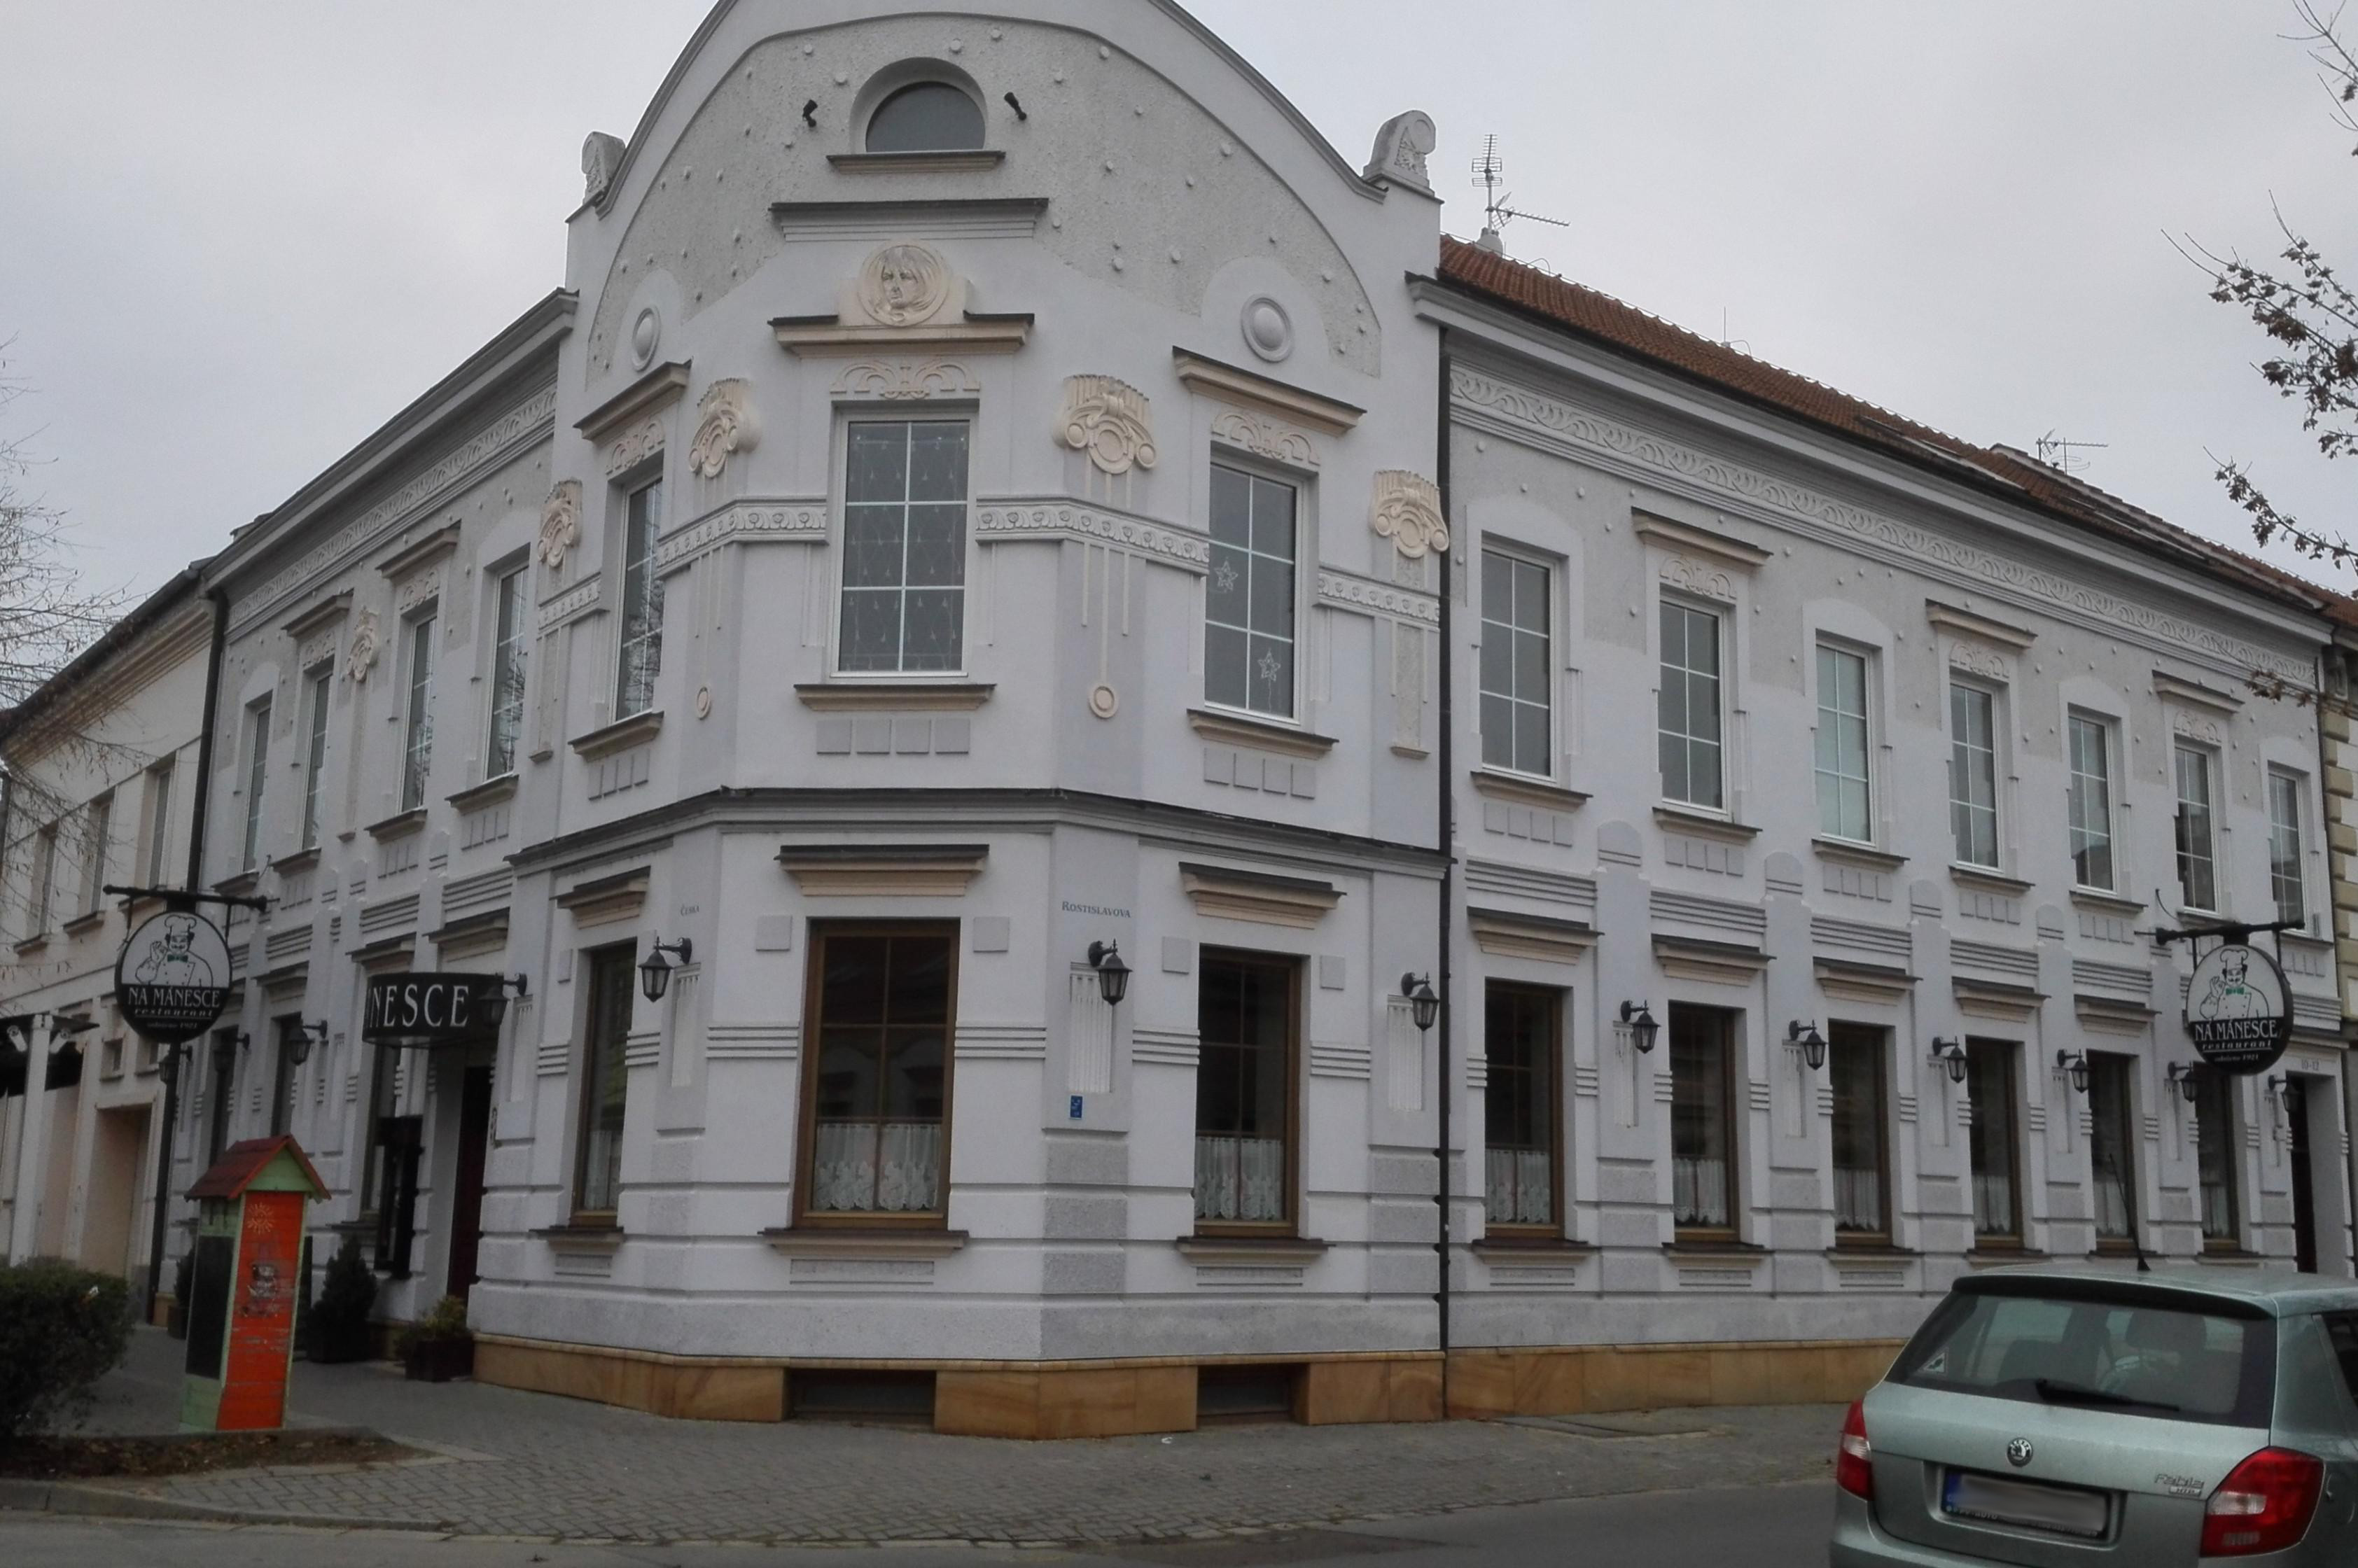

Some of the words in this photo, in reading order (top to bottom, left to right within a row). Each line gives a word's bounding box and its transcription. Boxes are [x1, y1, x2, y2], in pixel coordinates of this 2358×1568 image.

[1062, 901, 1131, 918] ROSTISLAVOVA
[128, 987, 148, 1006] NA
[153, 986, 221, 1008] MÁNESCE
[367, 983, 469, 1028] NESCE
[134, 1007, 213, 1016] restaurant
[2195, 1023, 2212, 1041] NA
[2216, 1019, 2277, 1040] MÁNESCE
[2202, 1040, 2271, 1050] restaurant
[2154, 1474, 2205, 1489] Fabia
